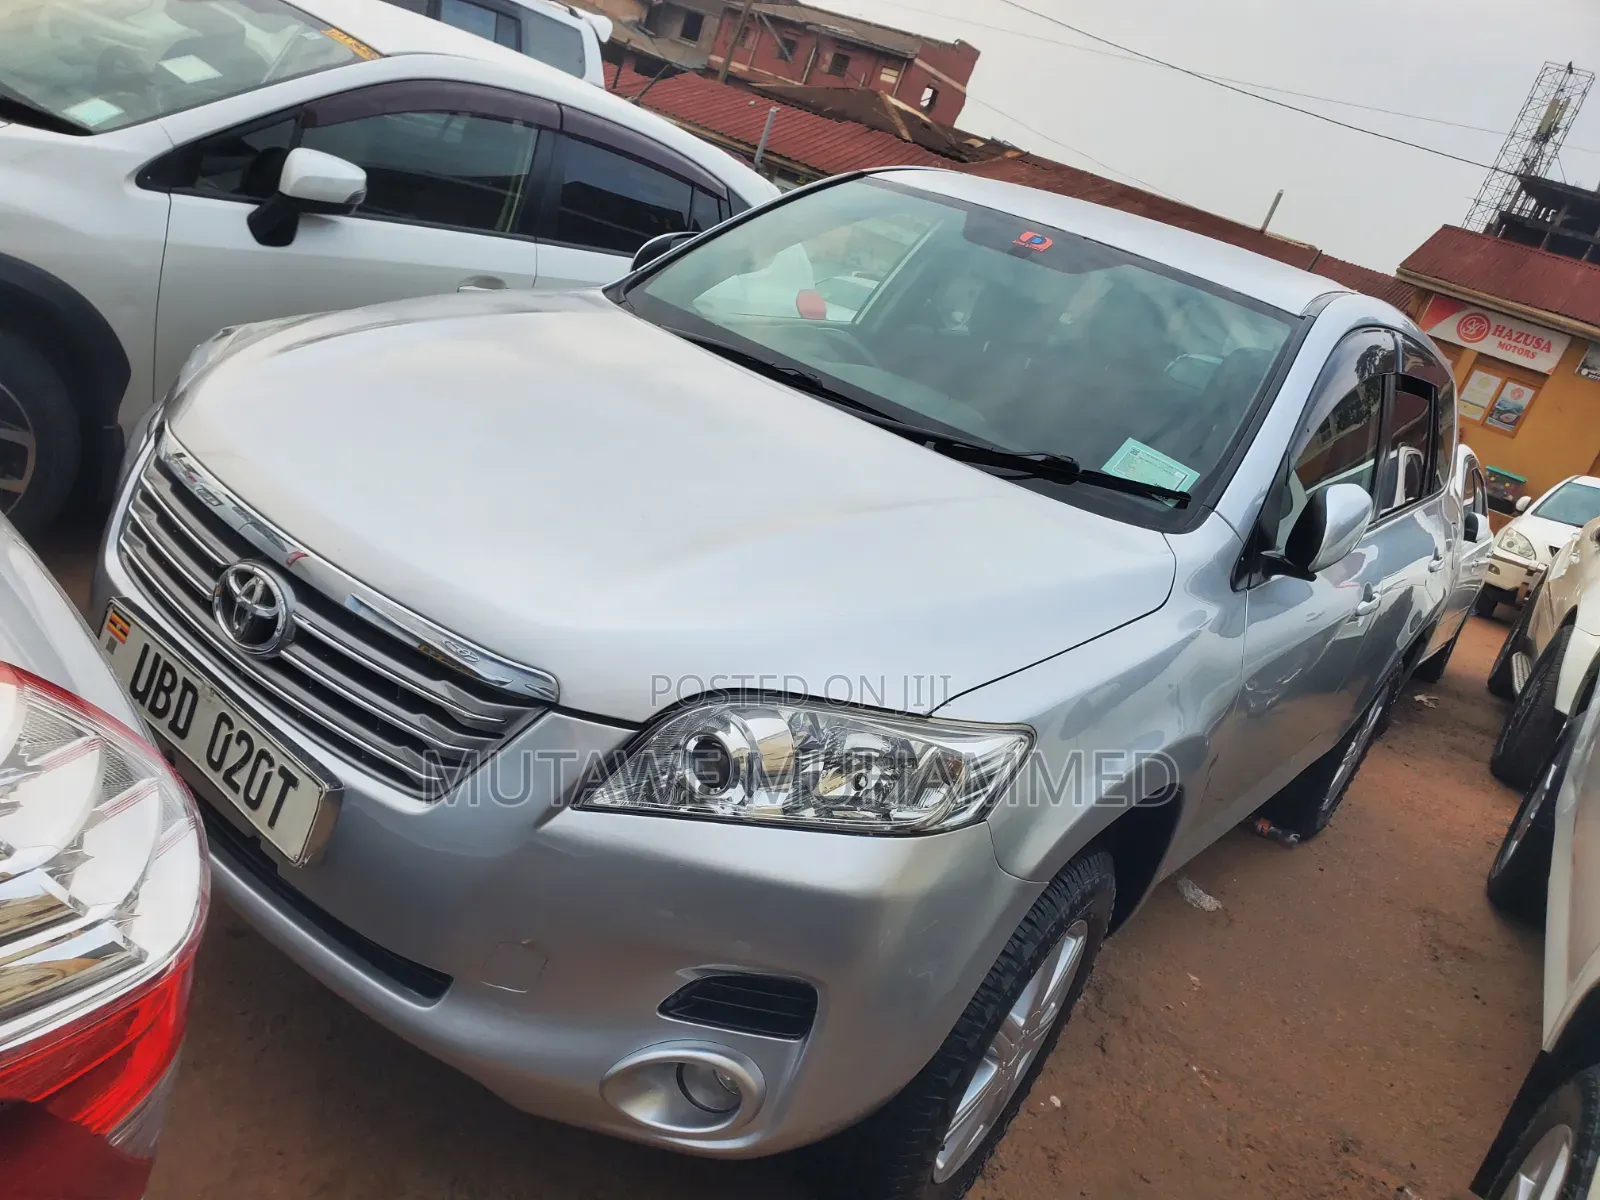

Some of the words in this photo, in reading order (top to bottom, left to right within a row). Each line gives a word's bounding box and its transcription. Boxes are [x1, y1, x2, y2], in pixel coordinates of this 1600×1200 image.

[1491, 325, 1552, 353] HAZUSA
[1497, 341, 1537, 359] MOTORS
[130, 642, 198, 740] UBD
[206, 711, 299, 830] 020T
